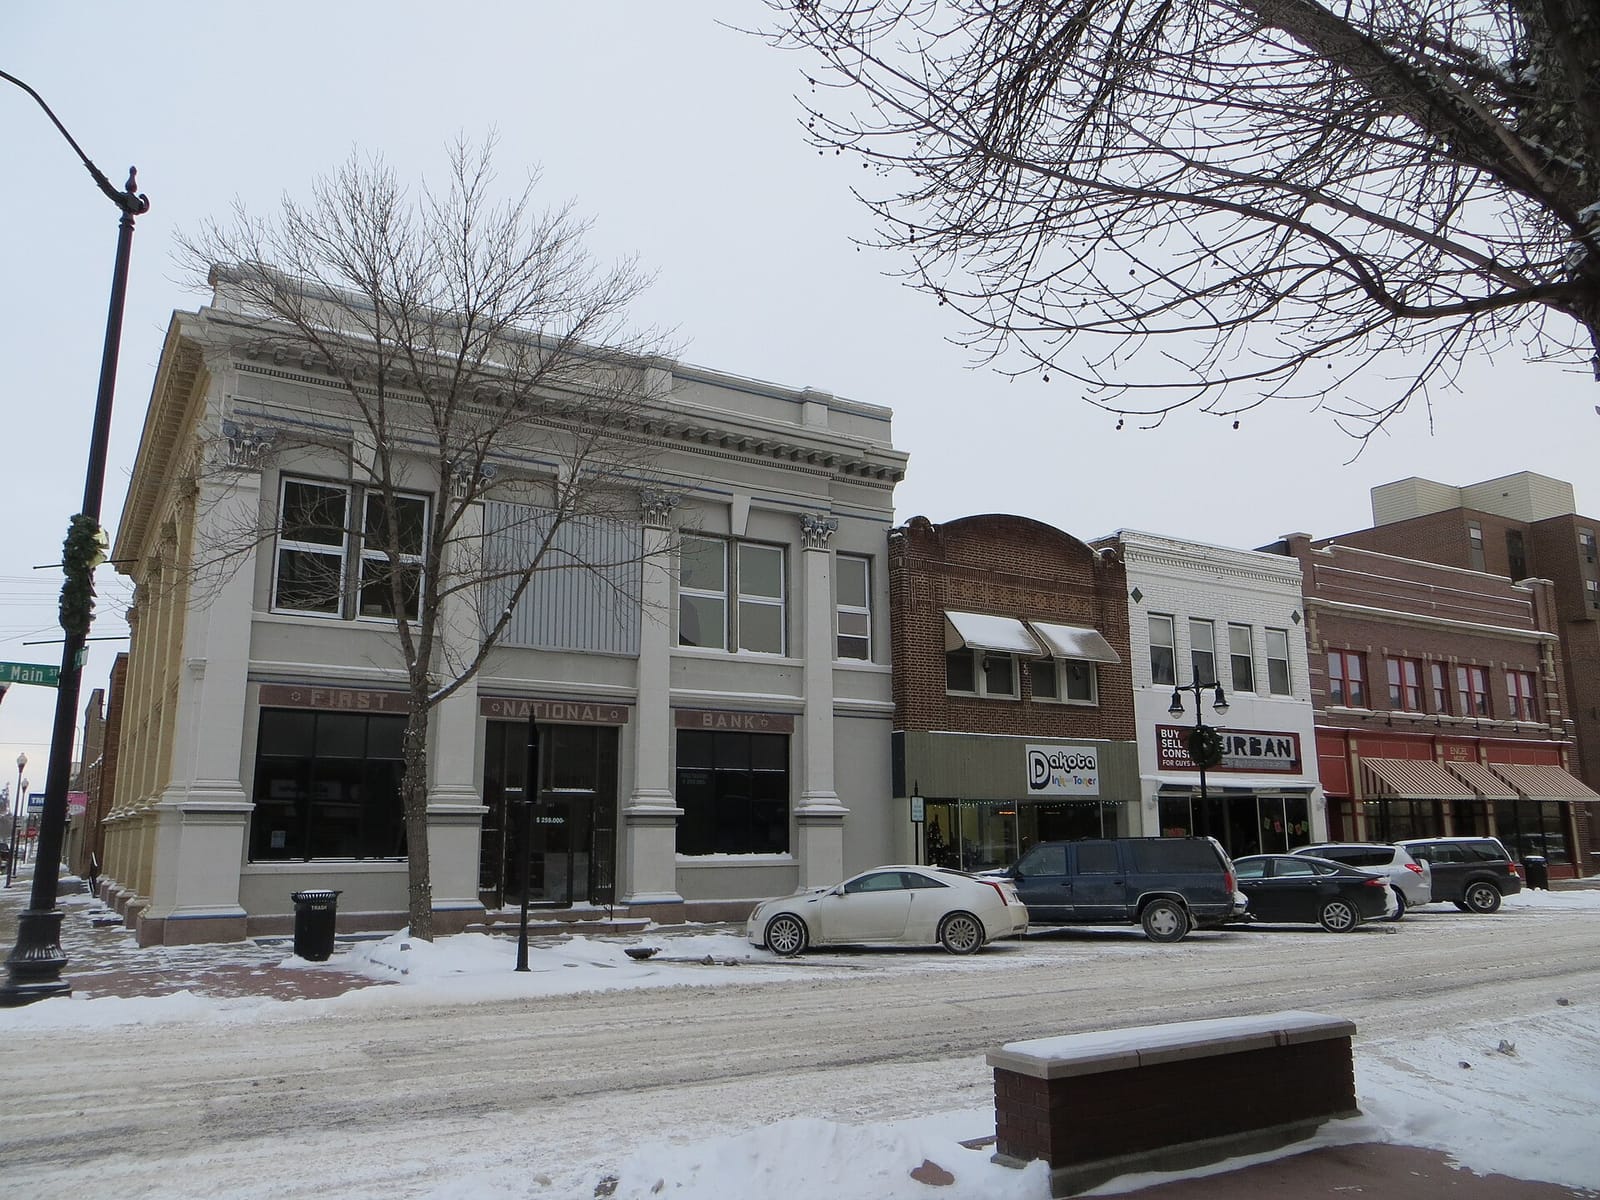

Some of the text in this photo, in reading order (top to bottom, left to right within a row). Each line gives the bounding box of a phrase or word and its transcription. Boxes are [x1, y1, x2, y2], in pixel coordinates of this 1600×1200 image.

[10, 665, 44, 682] Main
[310, 688, 389, 710] FIRST
[502, 700, 608, 721] NATIONAL
[702, 712, 755, 729] BANK
[1160, 729, 1180, 739] BUY
[1161, 738, 1183, 749] SELL
[1221, 736, 1291, 757] URBAN
[1162, 749, 1190, 759] CONSI
[1028, 750, 1096, 790] Dakota
[1162, 759, 1175, 767] FOR
[1051, 775, 1097, 788] Ink Toner
